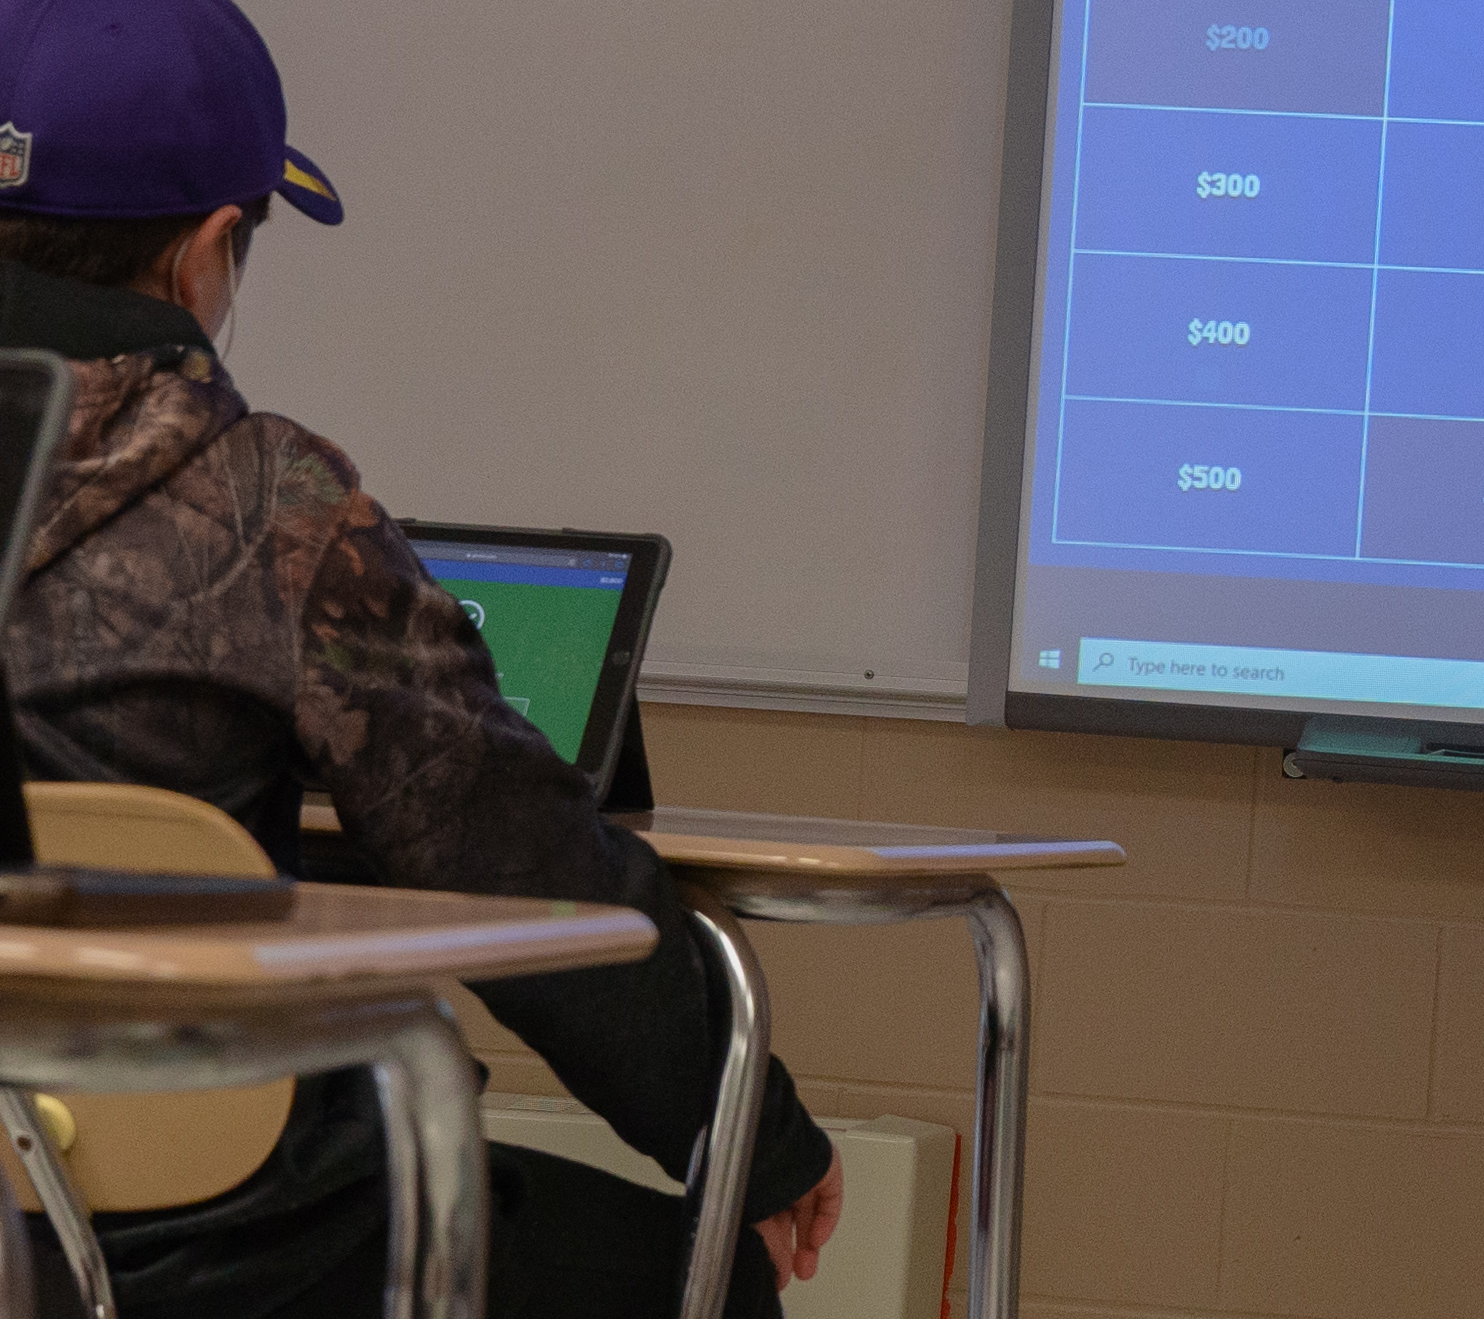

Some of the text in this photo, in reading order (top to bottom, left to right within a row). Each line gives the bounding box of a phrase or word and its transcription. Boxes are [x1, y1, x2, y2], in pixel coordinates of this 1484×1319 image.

[1206, 23, 1269, 54] $200
[1196, 170, 1260, 201] $300
[1187, 317, 1251, 348] $400
[1177, 462, 1242, 493] $500
[1128, 656, 1285, 682] Type here to search
